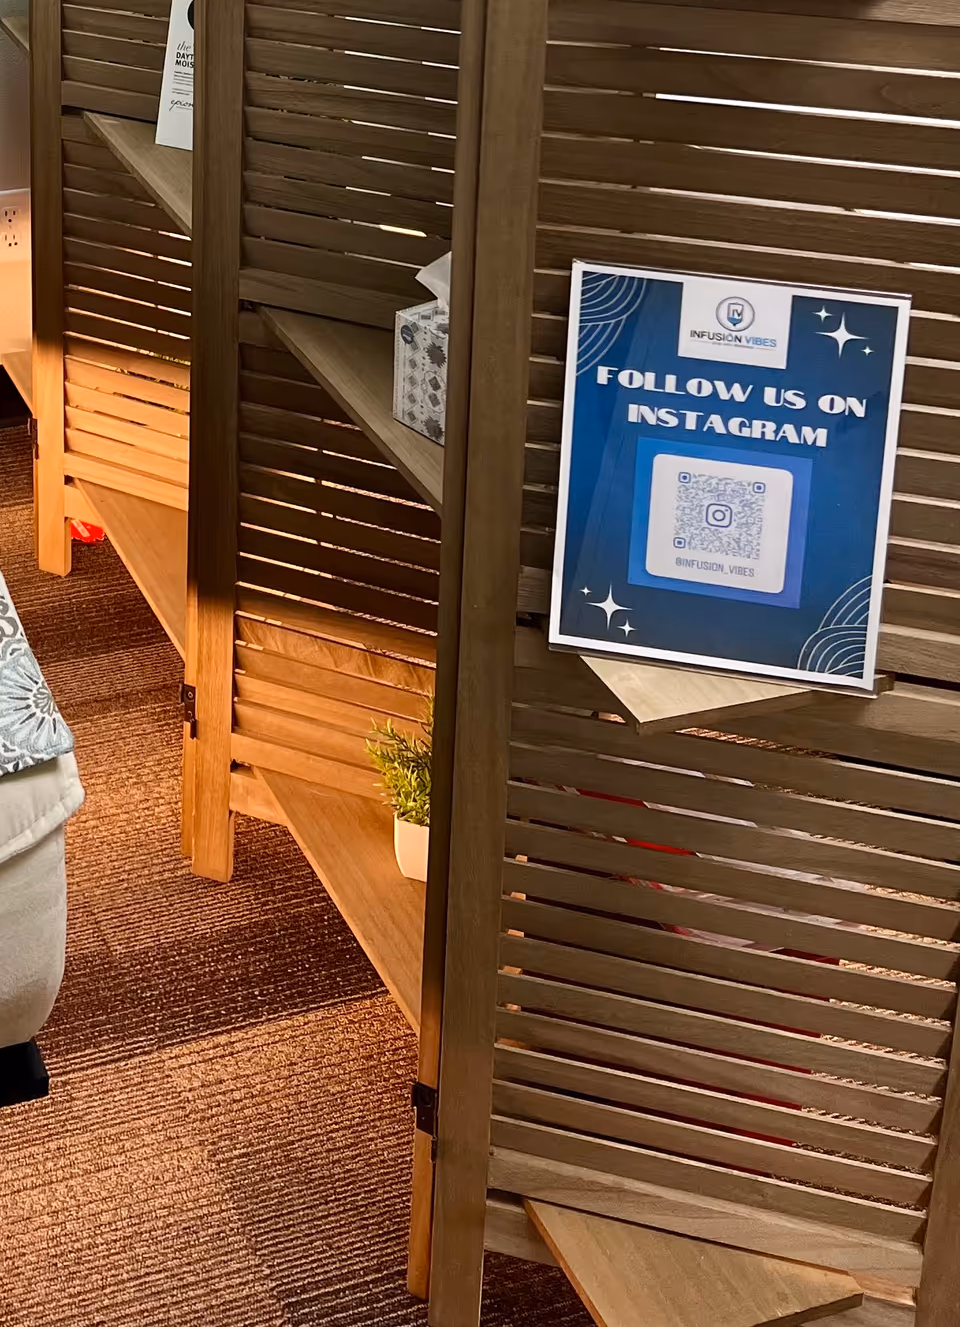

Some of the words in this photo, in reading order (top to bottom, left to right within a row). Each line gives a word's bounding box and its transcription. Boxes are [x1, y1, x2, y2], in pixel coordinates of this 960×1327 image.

[690, 329, 742, 344] INFUSION
[745, 335, 777, 348] VIBES
[596, 365, 754, 403] FOLLOW
[763, 386, 807, 411] US
[818, 393, 867, 419] ON
[627, 403, 829, 448] INSTAGRAM
[675, 556, 755, 578] @INFUSION_VIBES
